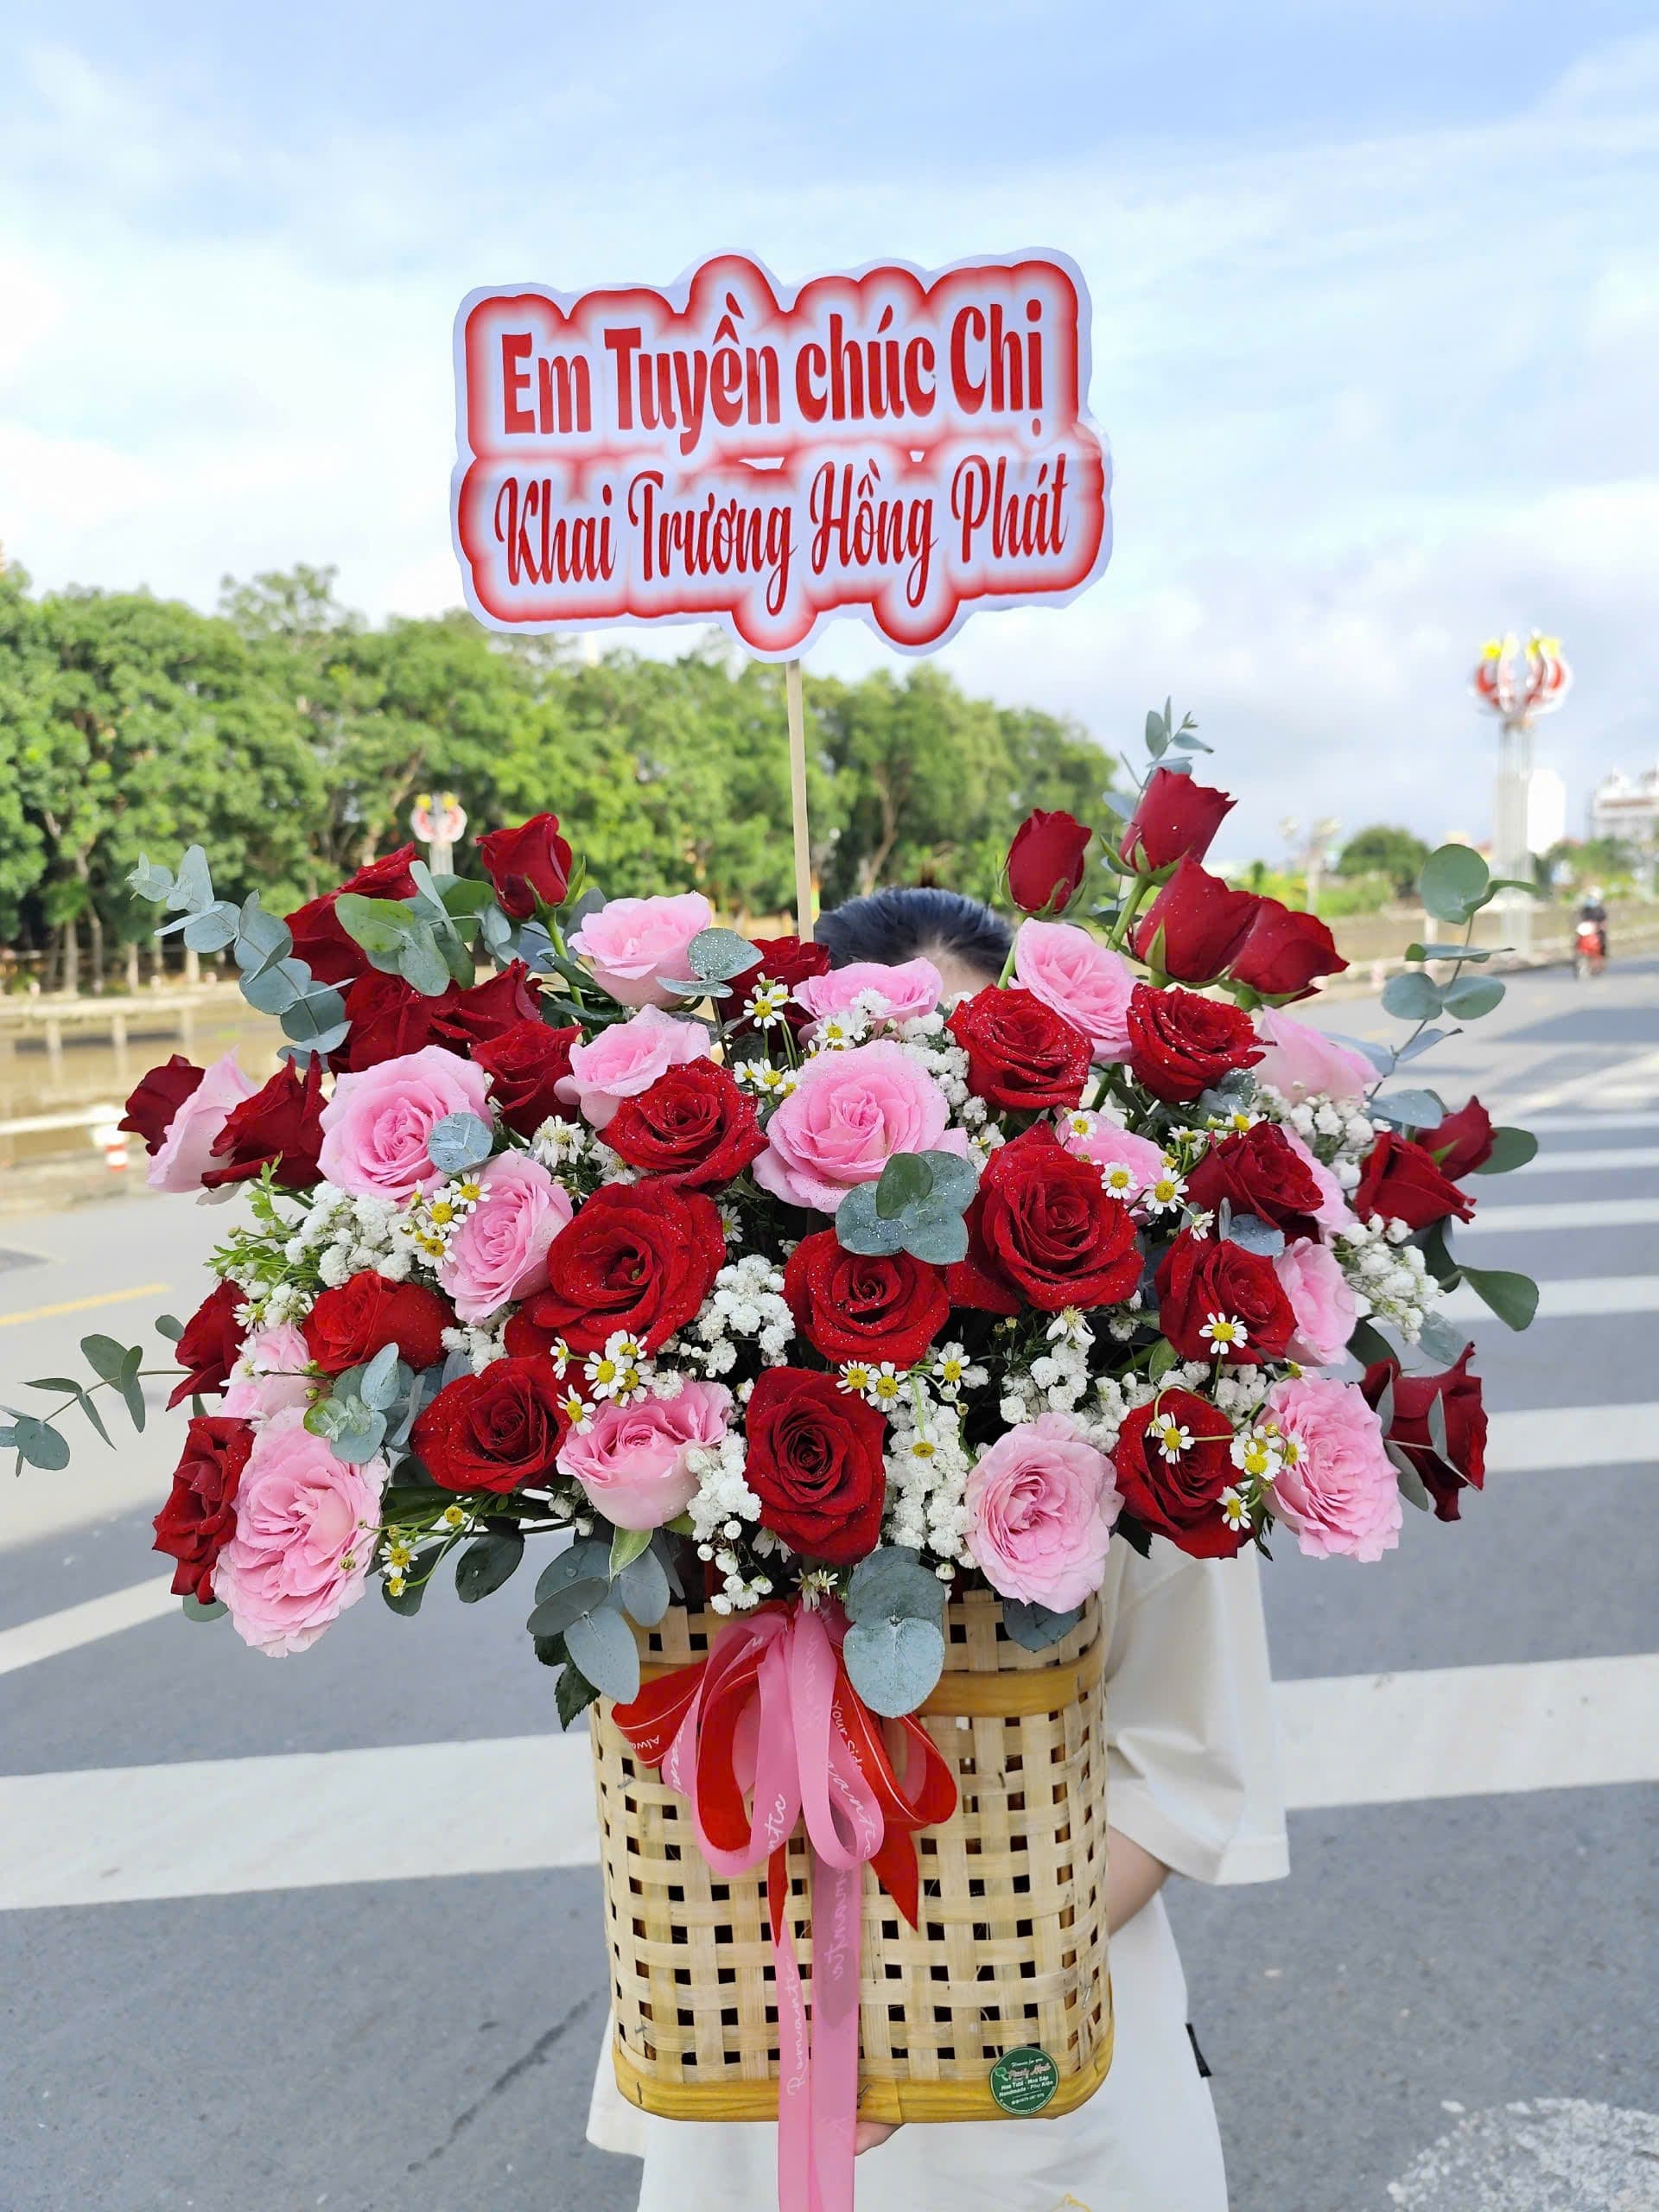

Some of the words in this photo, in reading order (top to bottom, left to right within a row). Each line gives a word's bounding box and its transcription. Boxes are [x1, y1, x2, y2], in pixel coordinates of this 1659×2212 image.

[501, 331, 591, 435] Em
[603, 292, 781, 456] Tuyền
[794, 304, 937, 423] chúc
[950, 298, 1044, 437] Chị
[493, 476, 616, 587] Khai
[627, 469, 797, 617] Trương
[810, 457, 939, 608] Hồng
[950, 452, 1070, 564] Phát
[631, 1734, 660, 1750] Alwa
[832, 1700, 849, 1737] Your
